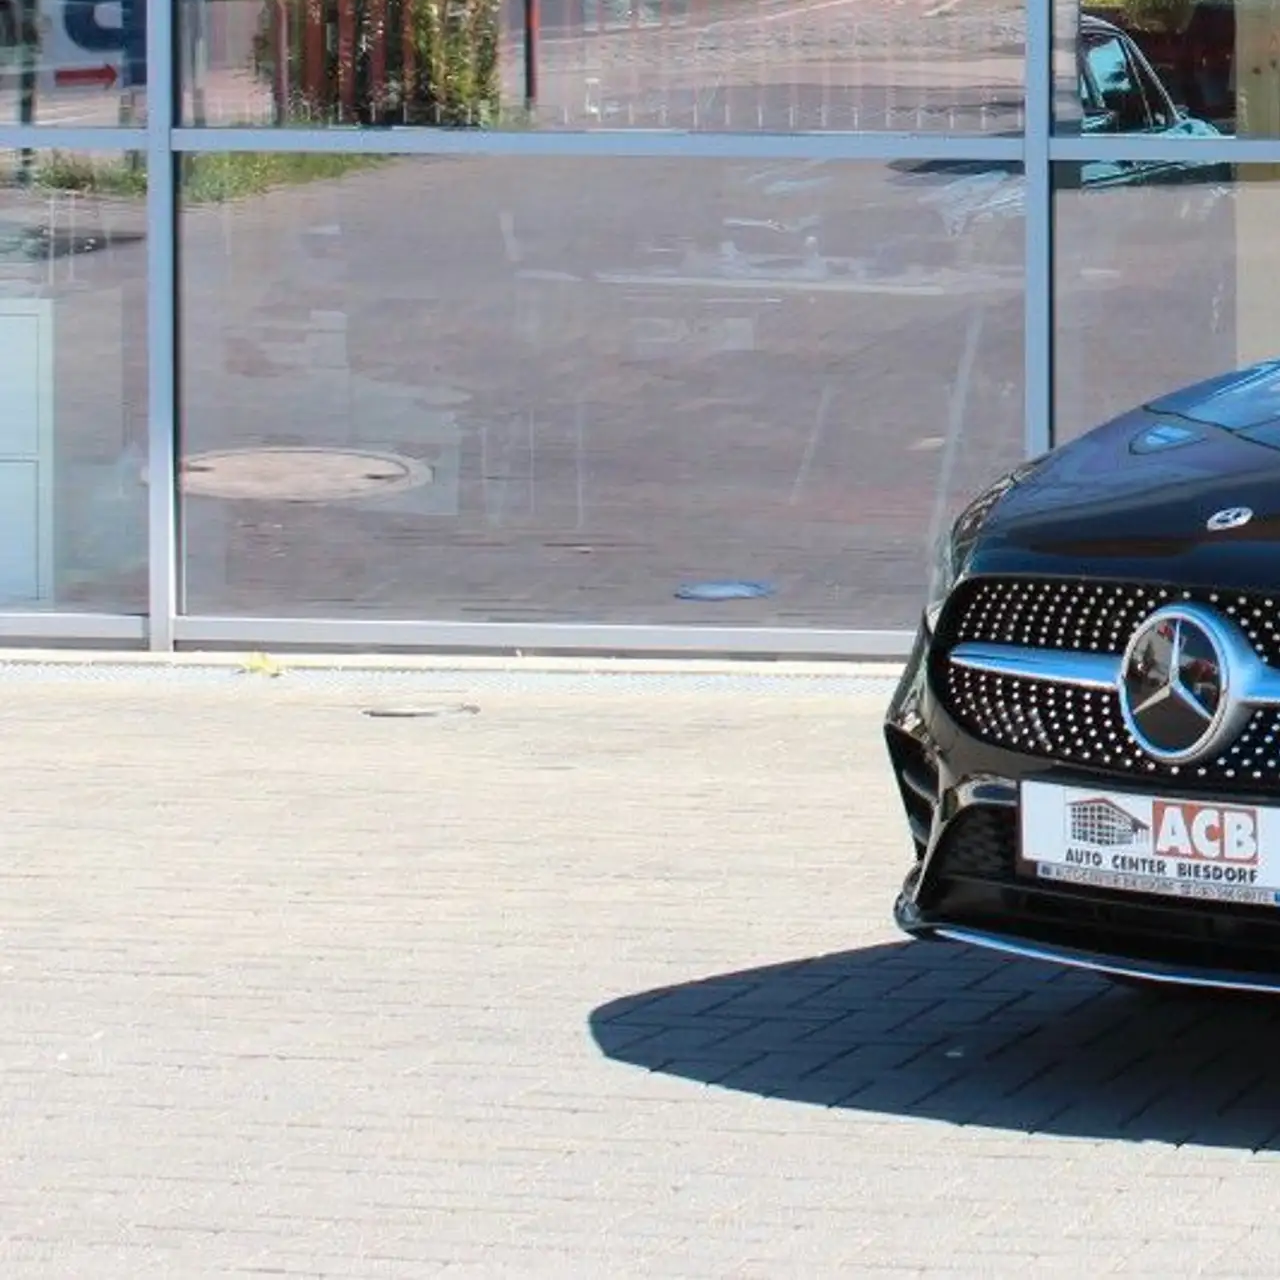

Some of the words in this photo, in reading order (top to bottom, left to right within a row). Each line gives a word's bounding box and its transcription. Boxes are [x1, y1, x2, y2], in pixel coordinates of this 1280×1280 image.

[1156, 804, 1259, 860] ACB
[1065, 847, 1103, 867] AUTO
[1111, 854, 1167, 876] CENTER
[1176, 861, 1259, 884] BIESDORF
